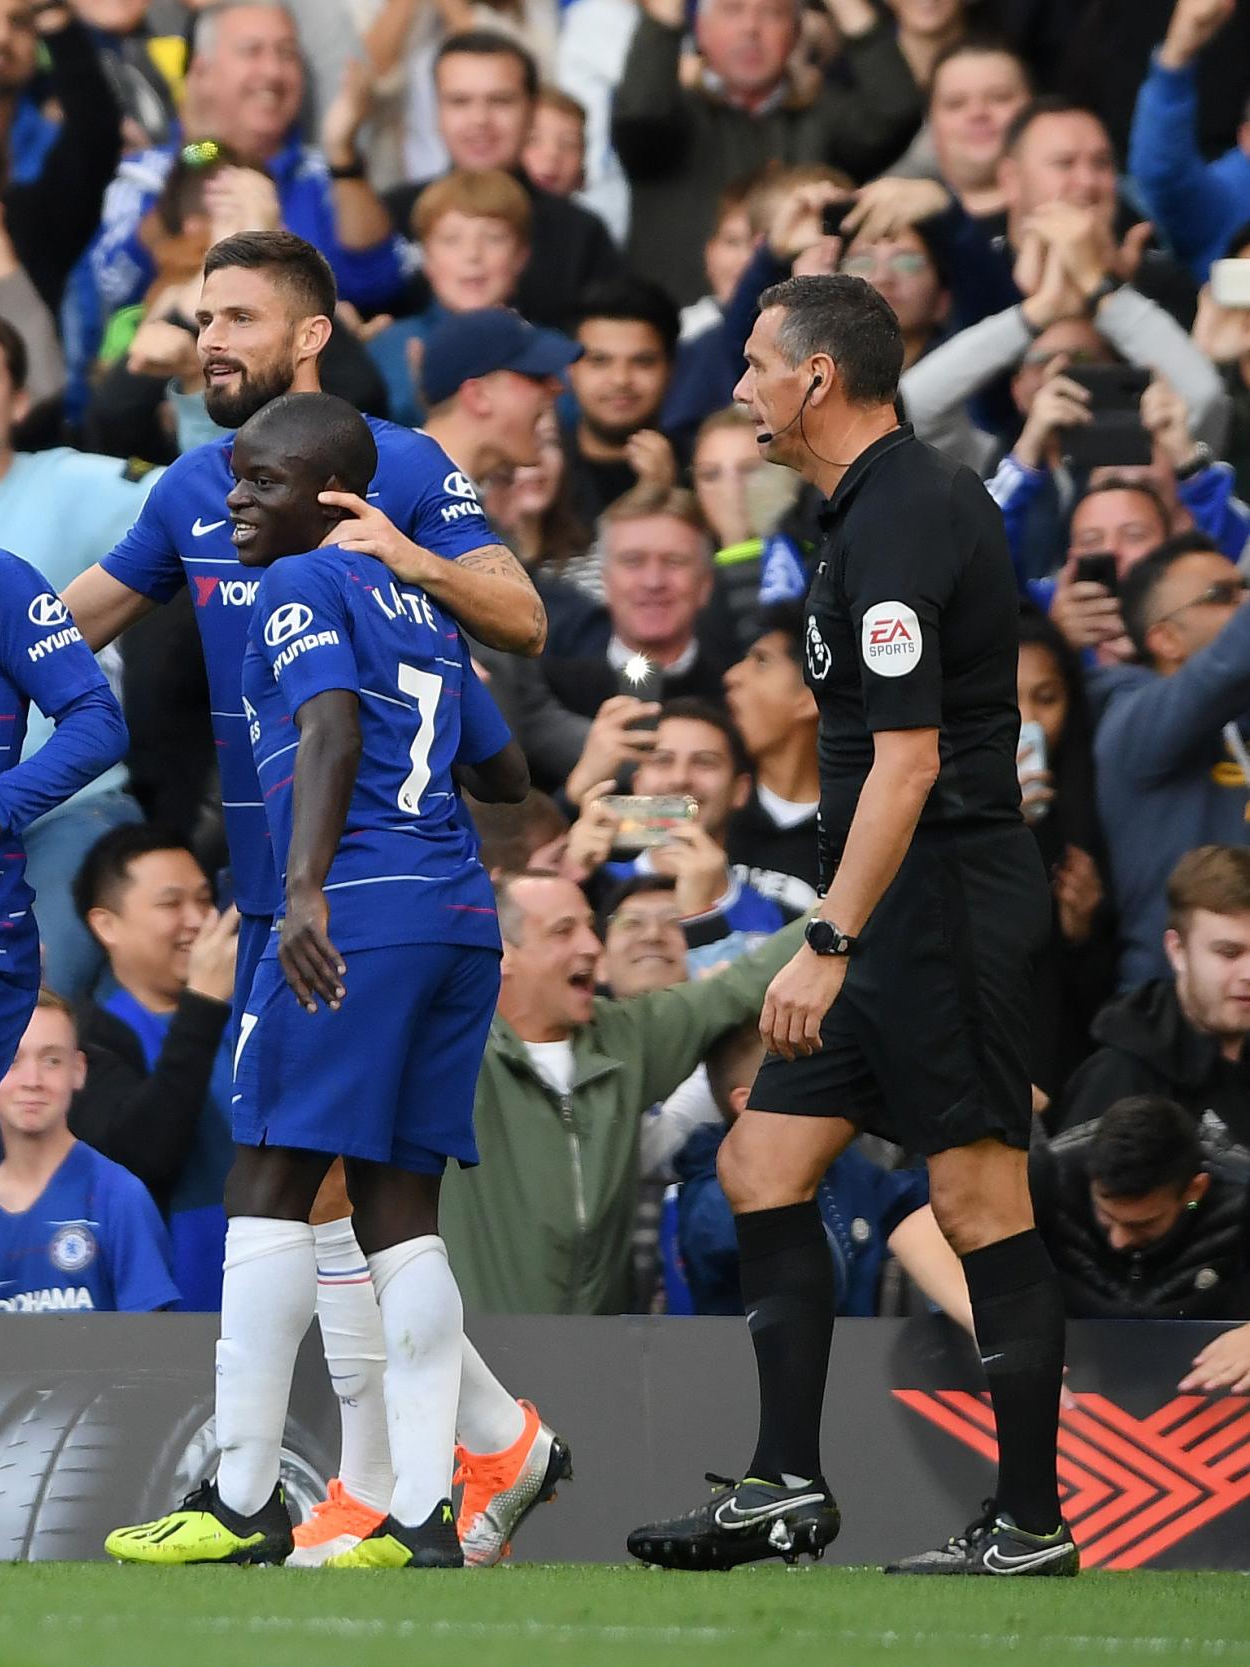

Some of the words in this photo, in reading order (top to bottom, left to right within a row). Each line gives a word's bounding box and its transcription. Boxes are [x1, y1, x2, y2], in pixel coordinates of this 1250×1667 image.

[28, 626, 84, 662] HYUND
[870, 618, 912, 644] EA
[273, 630, 340, 682] HYUNDAI
[869, 642, 915, 657] SPORTS
[397, 662, 443, 816] 7
